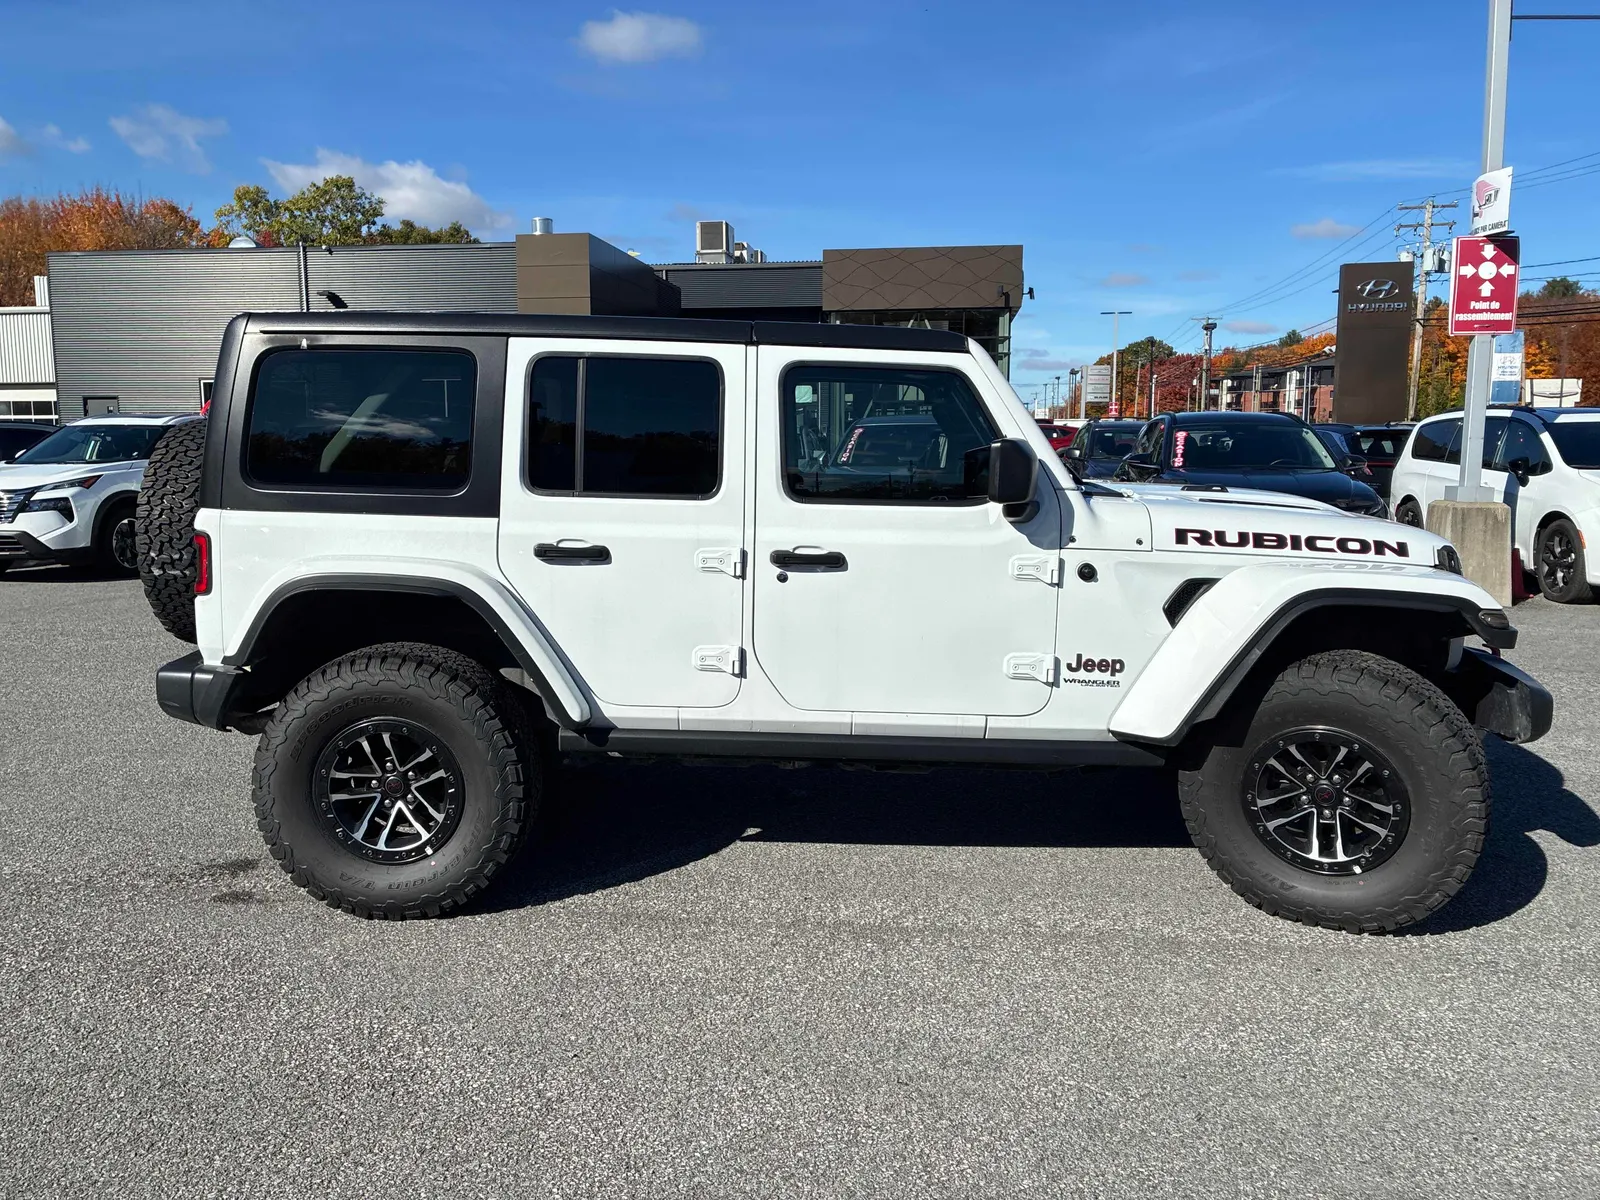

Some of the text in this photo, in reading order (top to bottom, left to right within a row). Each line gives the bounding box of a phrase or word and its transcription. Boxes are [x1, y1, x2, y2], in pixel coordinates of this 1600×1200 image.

[1348, 302, 1408, 313] HYUNDAI
[1470, 300, 1500, 310] Point de
[1455, 312, 1513, 321] rassemblement
[1174, 431, 1188, 467] OCCASION
[1174, 527, 1410, 558] RUBICON
[1066, 653, 1126, 677] Jeep
